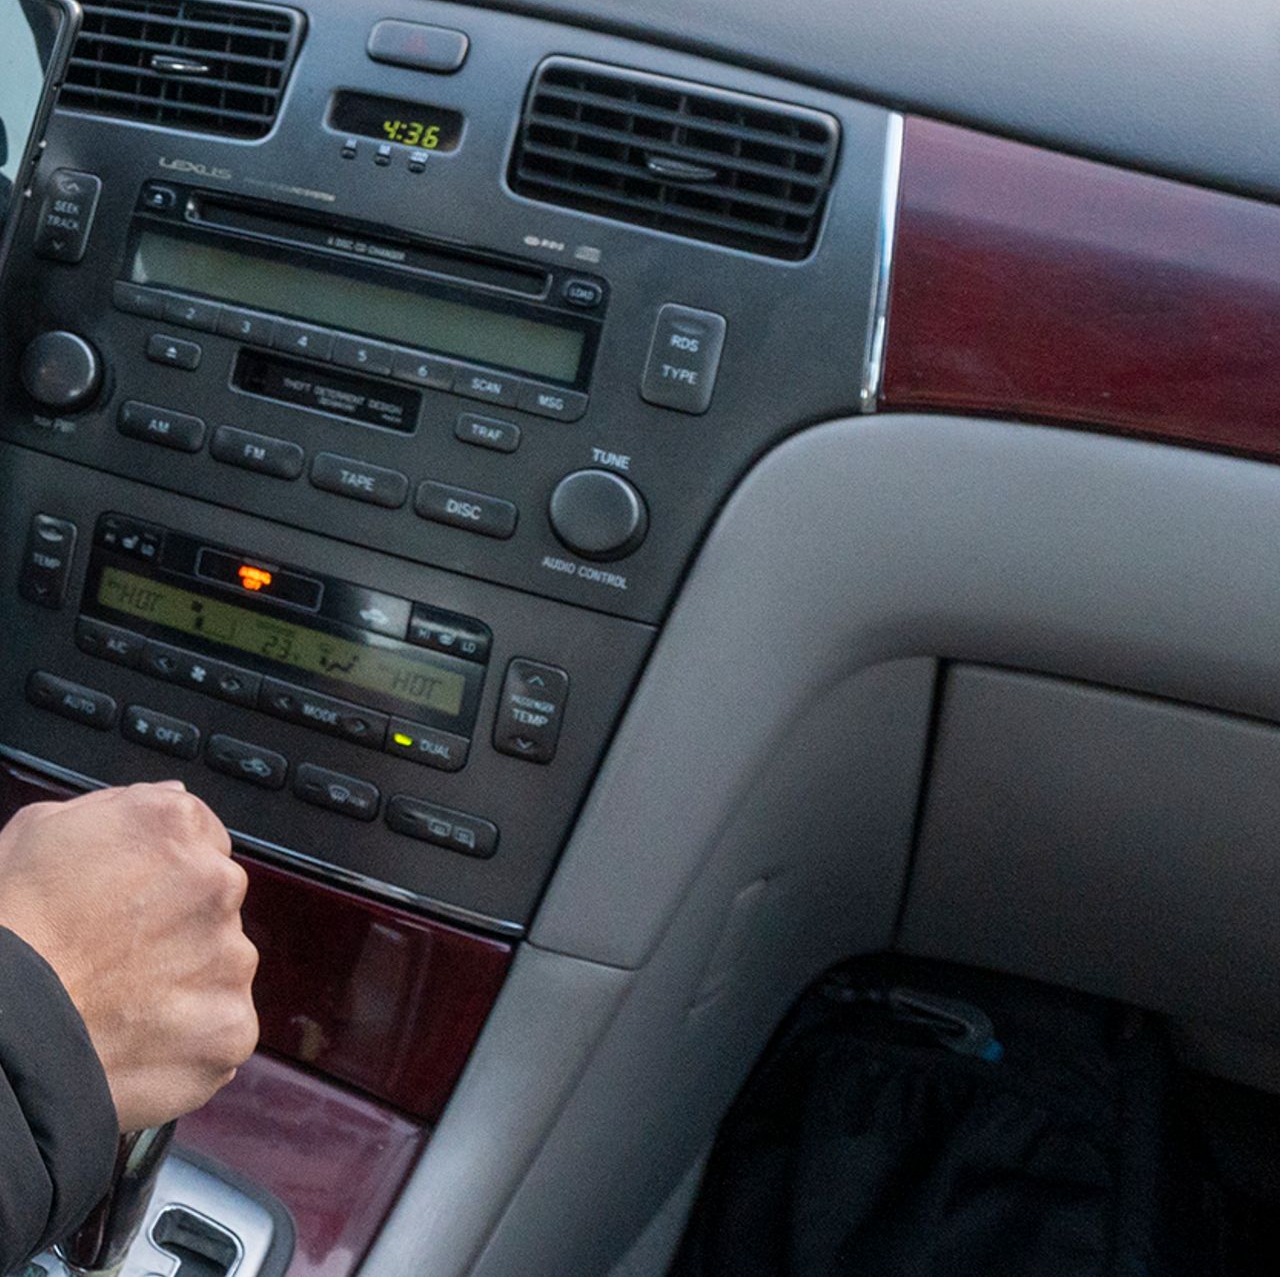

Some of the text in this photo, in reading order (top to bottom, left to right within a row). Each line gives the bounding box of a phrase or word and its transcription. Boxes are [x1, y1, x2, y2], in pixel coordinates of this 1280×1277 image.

[383, 120, 440, 149] 4:36
[159, 157, 232, 180] LEXUS
[53, 200, 79, 215] SEEK
[47, 214, 79, 231] TRACK
[185, 307, 196, 320] 2
[241, 321, 251, 334] 3
[297, 335, 308, 348] 4
[670, 333, 699, 353] RDS
[357, 350, 368, 363] 5
[418, 364, 428, 377] 6
[661, 363, 698, 385] TYPE
[471, 377, 502, 395] SCAN
[539, 394, 564, 411] MSG
[148, 419, 171, 434] AM
[471, 423, 502, 441] TRAF
[243, 444, 266, 462] FM
[591, 448, 631, 470] TUNE
[340, 470, 376, 492] TAPE
[446, 498, 481, 521] DISC
[33, 552, 61, 570] TEMP
[542, 555, 628, 590] AUDIO CONTROL
[462, 640, 477, 654] LO
[393, 672, 442, 702] HOT
[63, 694, 97, 715] AUTO
[303, 702, 338, 724] MODE
[512, 708, 549, 728] TEMP
[155, 726, 183, 745] OFF
[419, 739, 450, 760] DUAL
